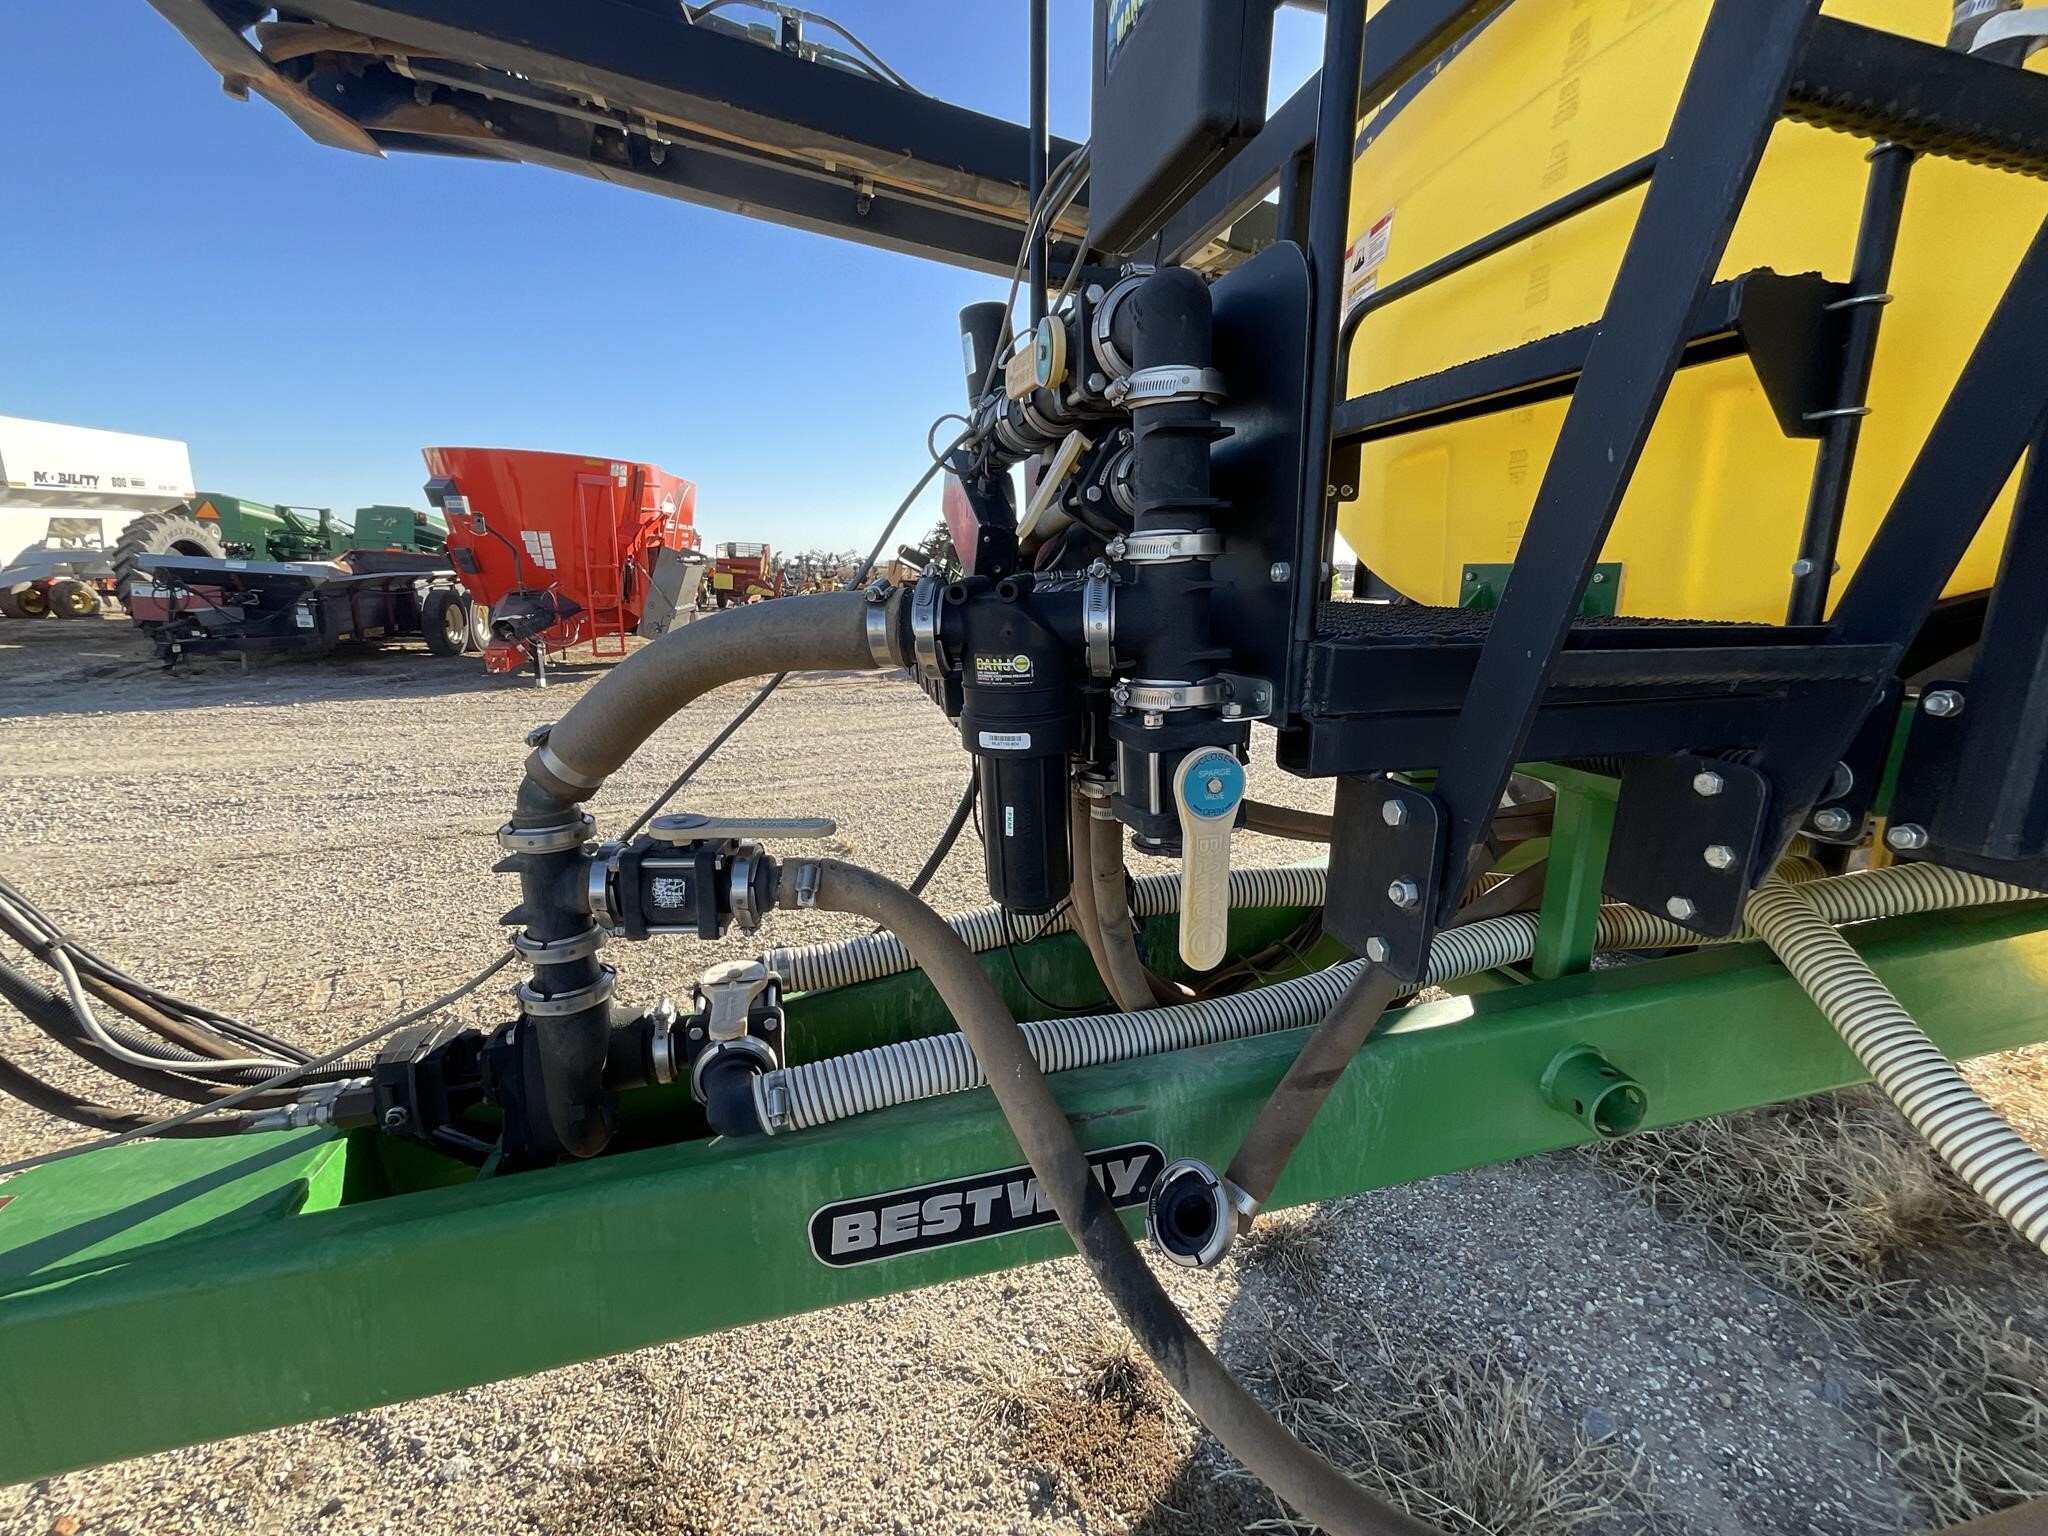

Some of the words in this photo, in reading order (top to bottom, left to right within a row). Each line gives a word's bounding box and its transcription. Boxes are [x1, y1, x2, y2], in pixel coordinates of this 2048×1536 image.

[34, 471, 100, 486] MBILITY
[976, 654, 1031, 673] BANJO
[1198, 752, 1230, 766] CLOSE
[1198, 767, 1232, 779] SPARGE
[1204, 791, 1225, 801] VALVE
[1202, 807, 1225, 817] OPEN
[831, 1154, 1150, 1255] BESTWY
